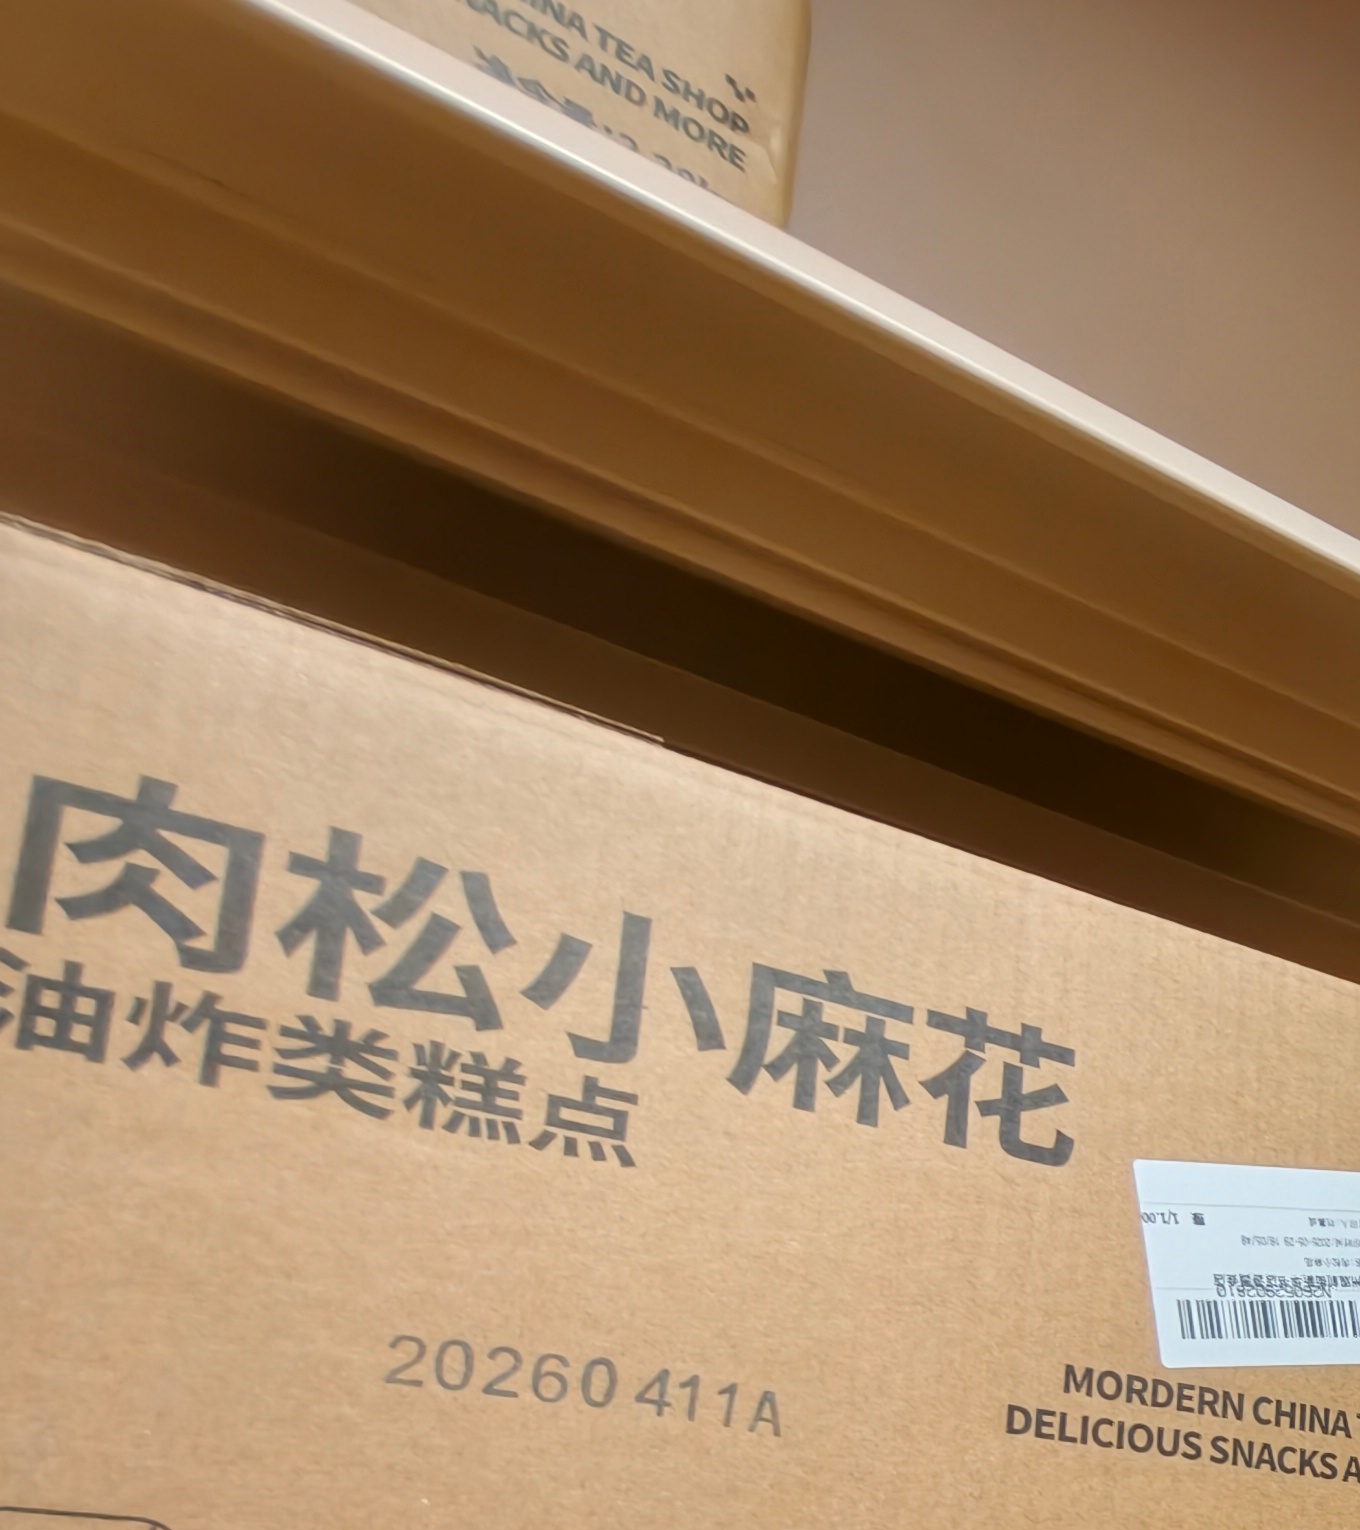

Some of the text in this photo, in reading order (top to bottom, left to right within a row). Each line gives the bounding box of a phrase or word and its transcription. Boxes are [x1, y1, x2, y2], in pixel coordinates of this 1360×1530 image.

[572, 53, 648, 107] AND
[652, 96, 747, 174] MORE
[592, 22, 656, 83] TEA
[660, 66, 751, 134] SHOP
[6, 774, 1076, 1167] 肉松小麻花
[0, 948, 640, 1168] 油炸类糕点
[1005, 1403, 1203, 1461] DELICIOUS
[1209, 1434, 1340, 1482] SNACKS
[1062, 1363, 1246, 1422] MORDERN
[1251, 1396, 1352, 1439] CHINA
